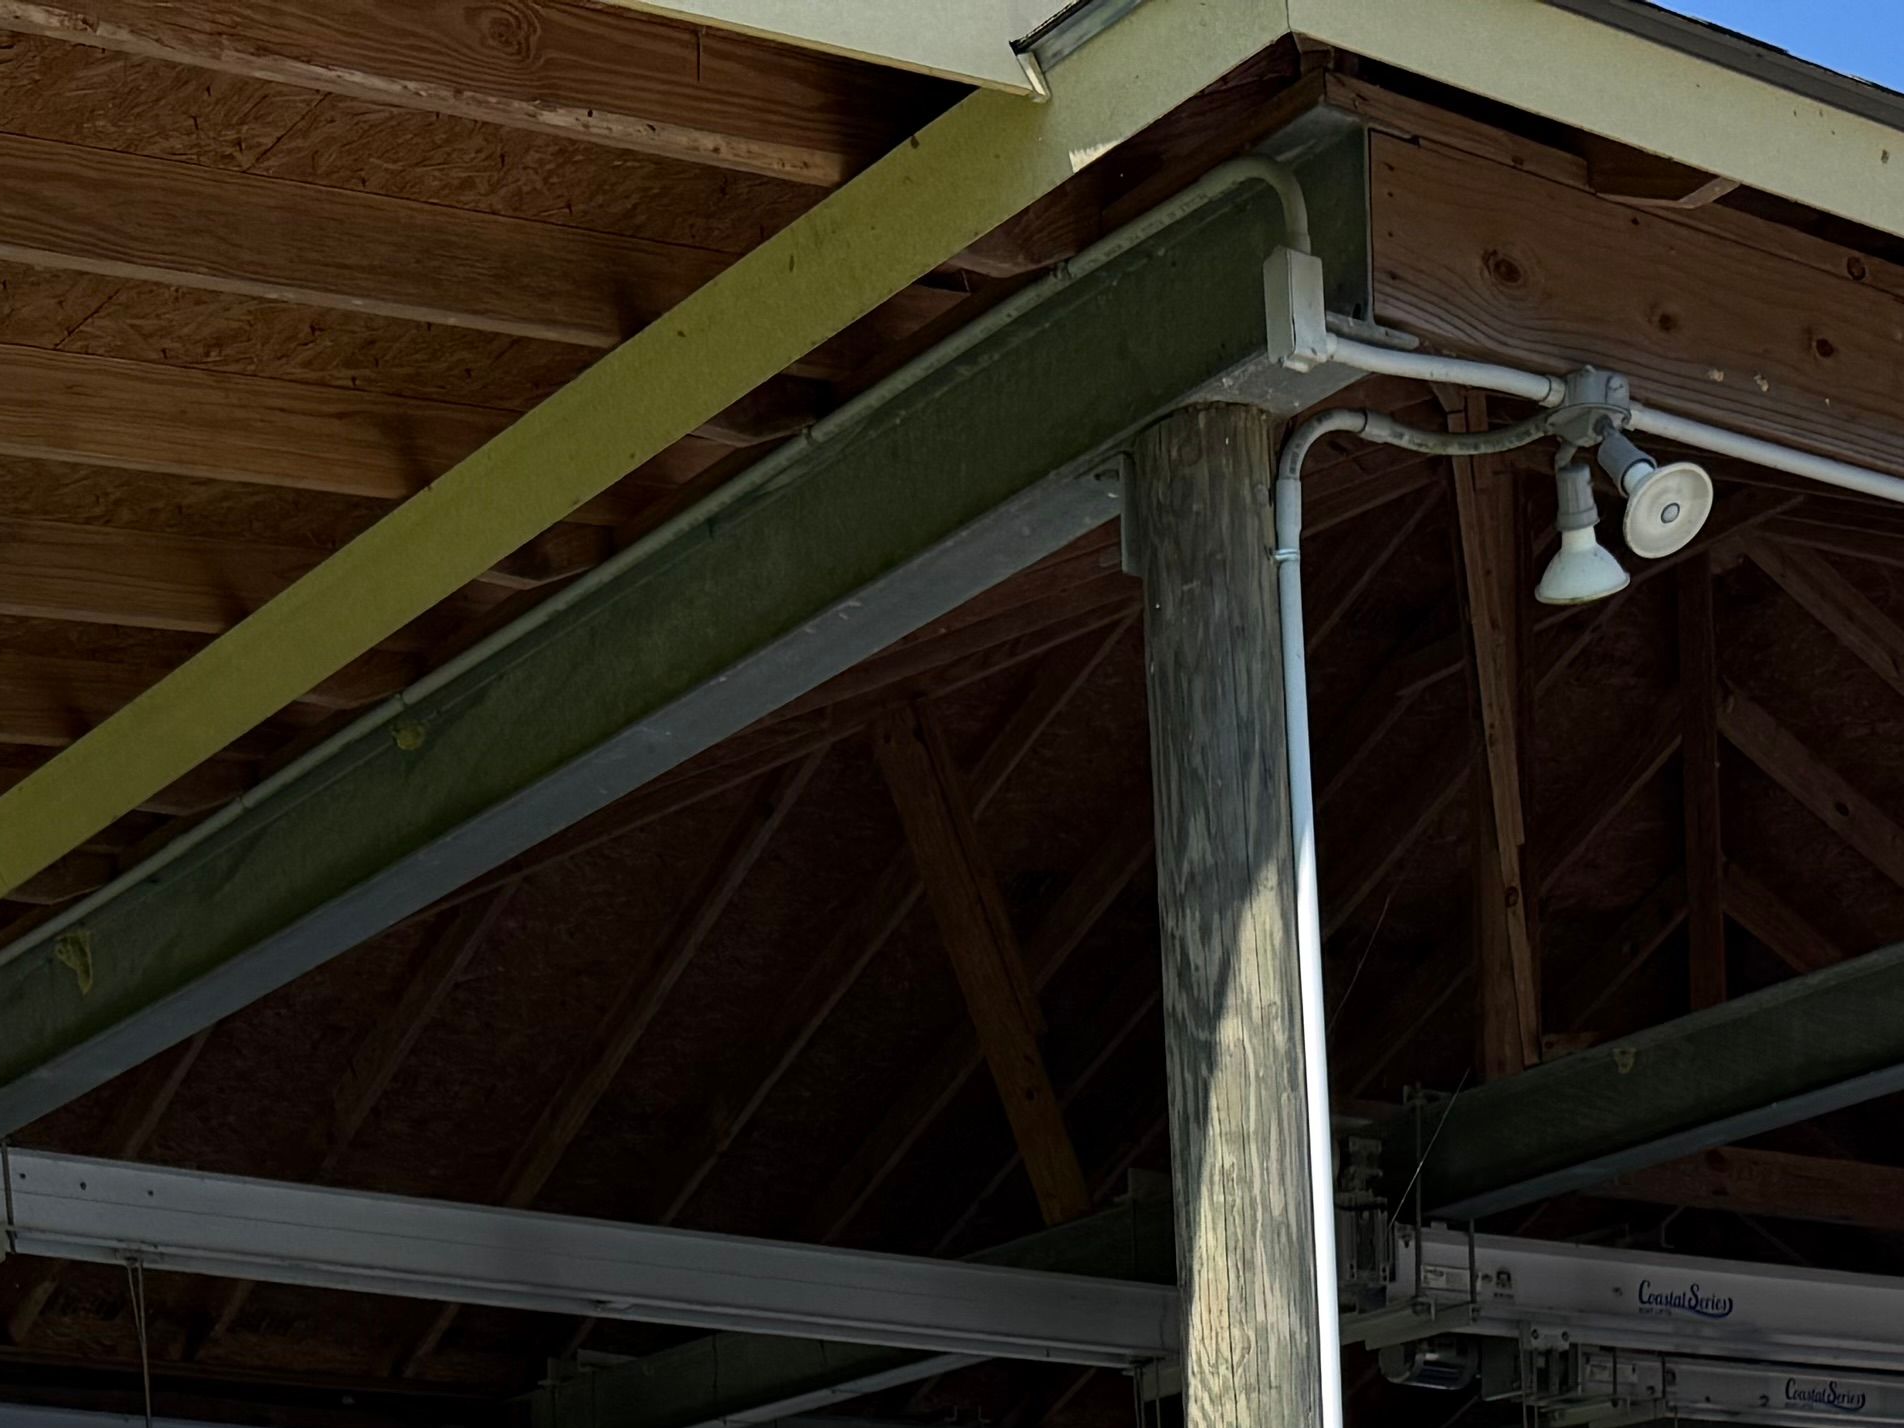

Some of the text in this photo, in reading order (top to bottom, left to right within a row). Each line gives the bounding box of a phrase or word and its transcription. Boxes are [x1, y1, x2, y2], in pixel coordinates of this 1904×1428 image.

[1638, 1279, 1733, 1318] Coastal Series
[1827, 1380, 1866, 1411] Series
